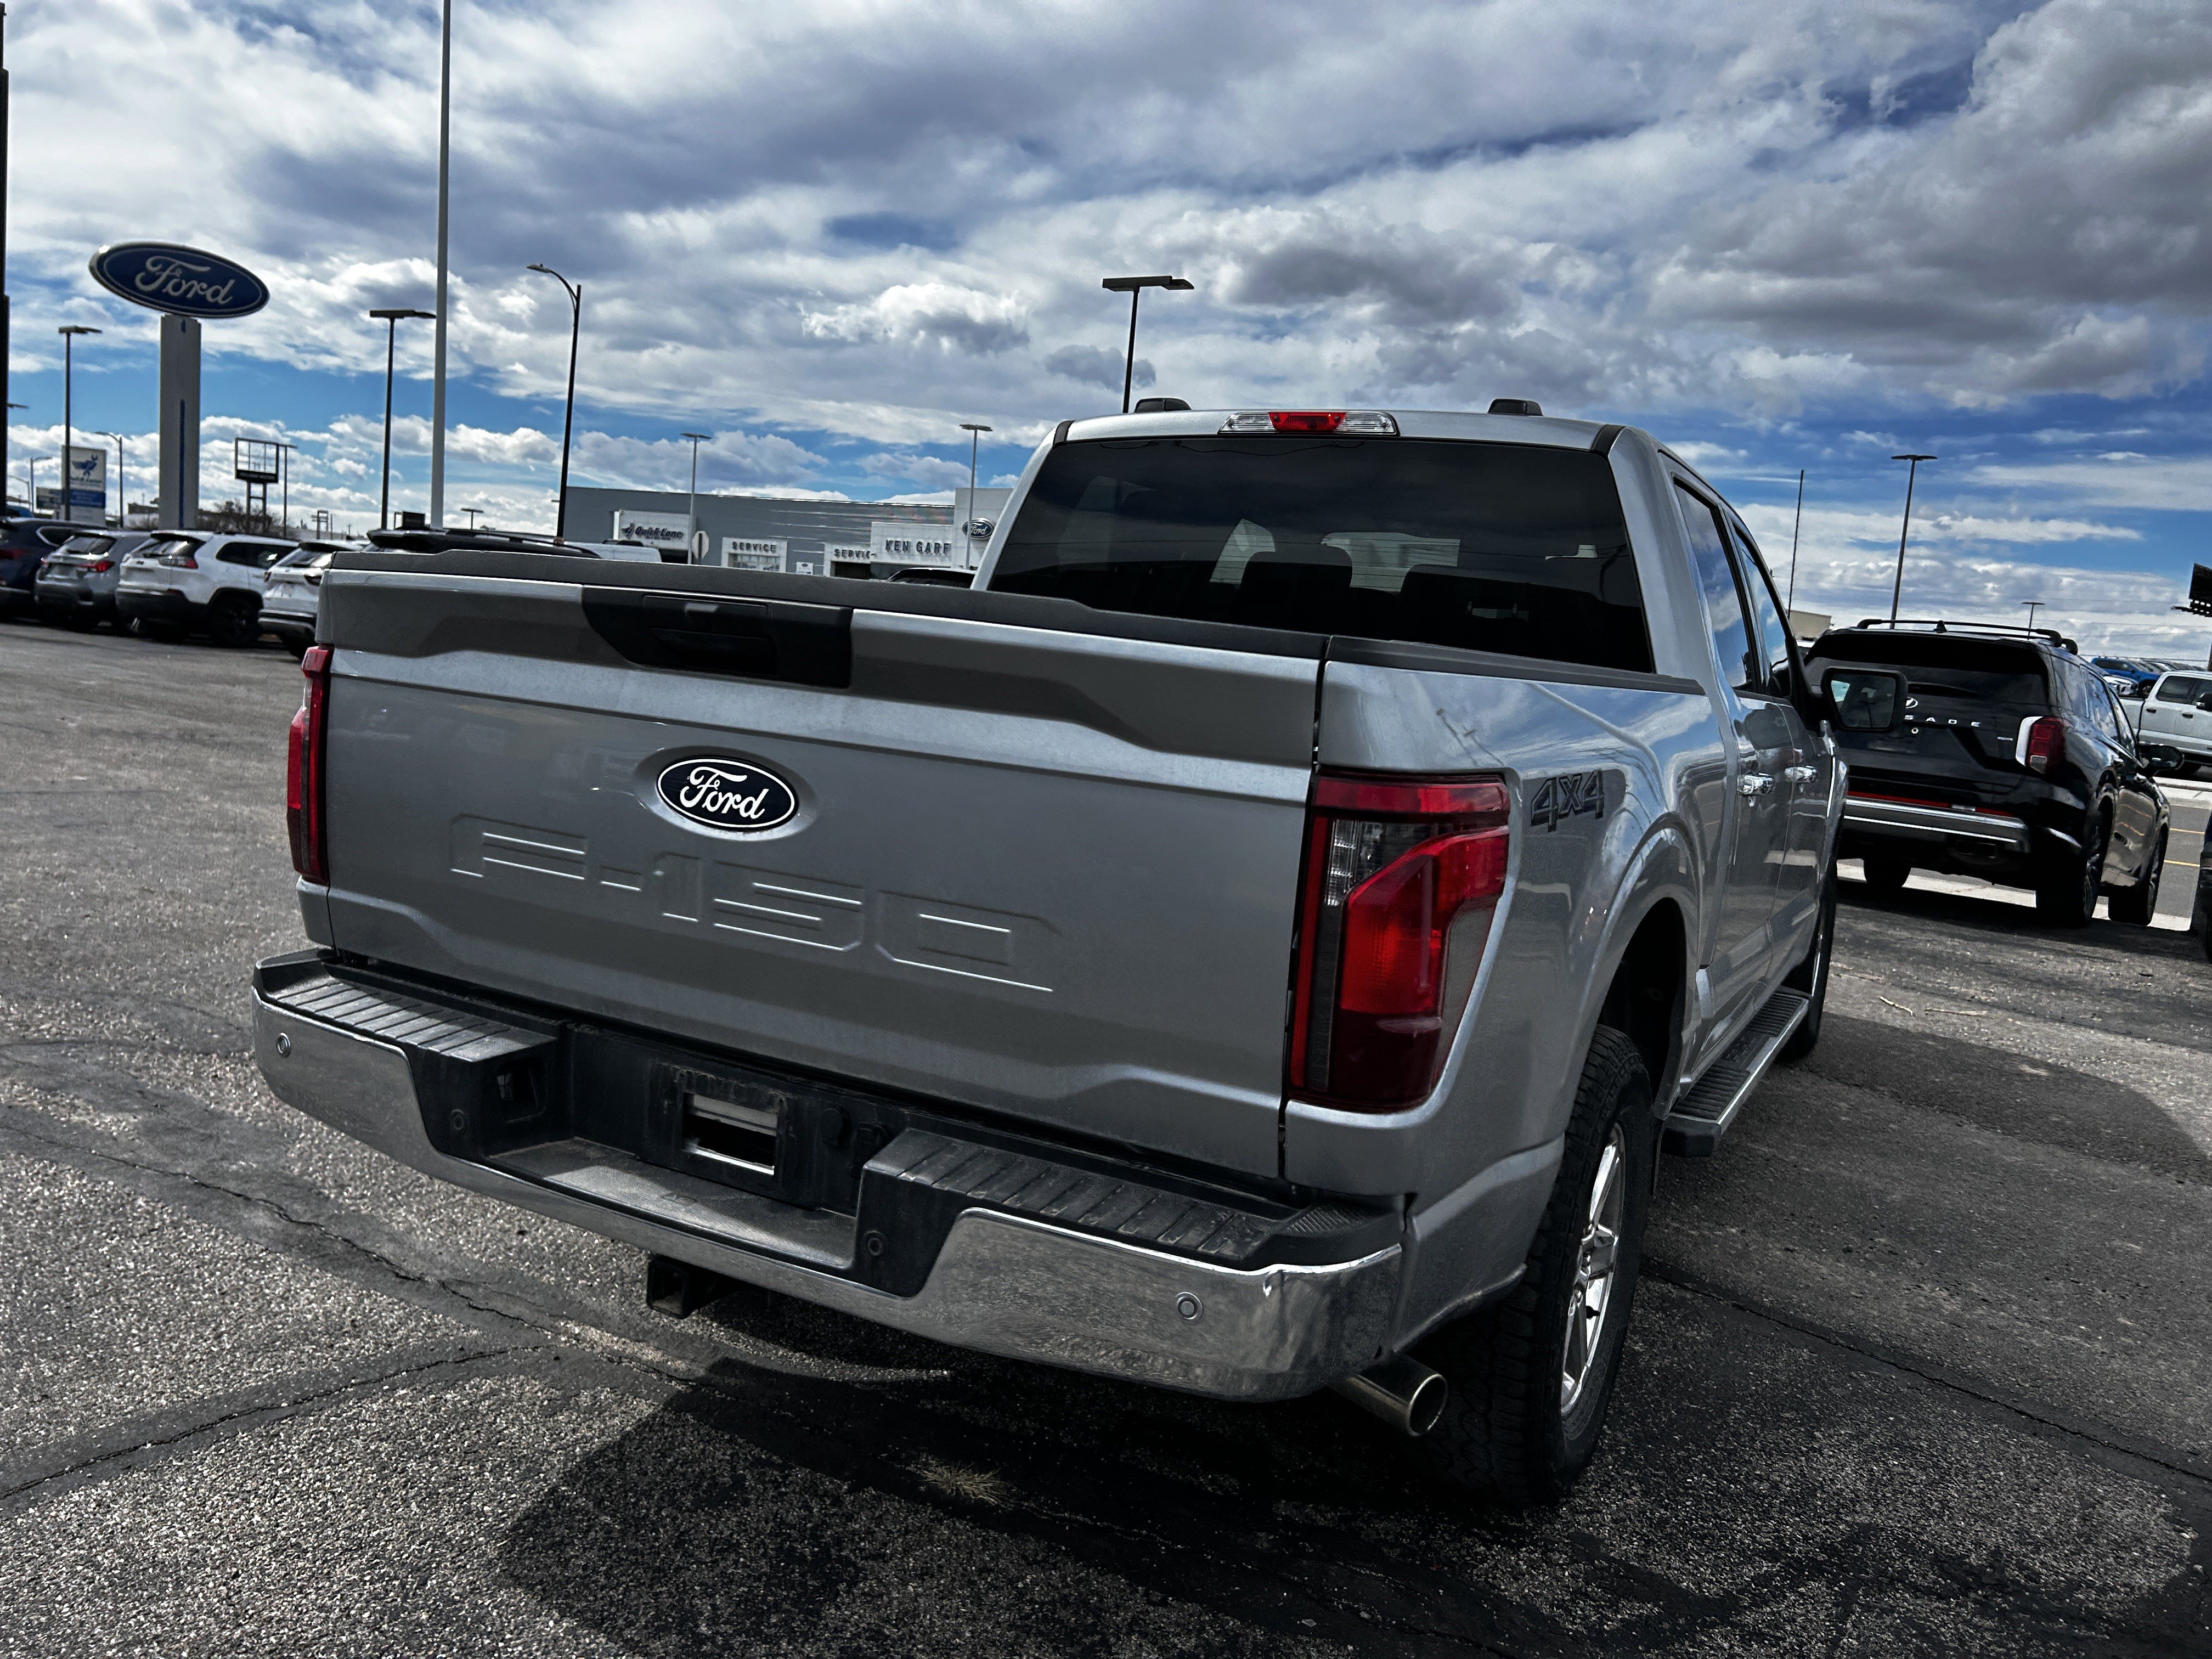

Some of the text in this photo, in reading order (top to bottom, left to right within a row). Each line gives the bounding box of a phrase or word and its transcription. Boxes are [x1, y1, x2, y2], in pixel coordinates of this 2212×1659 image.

[134, 256, 235, 304] Ford
[635, 526, 661, 537] Quick
[661, 528, 684, 539] Lane
[732, 541, 776, 552] SERVICE
[885, 540, 951, 554] KEN GARF
[834, 549, 871, 558] SERVIC
[1904, 714, 1980, 727] SADE
[680, 766, 769, 819] Ford
[449, 813, 1059, 991] F-150
